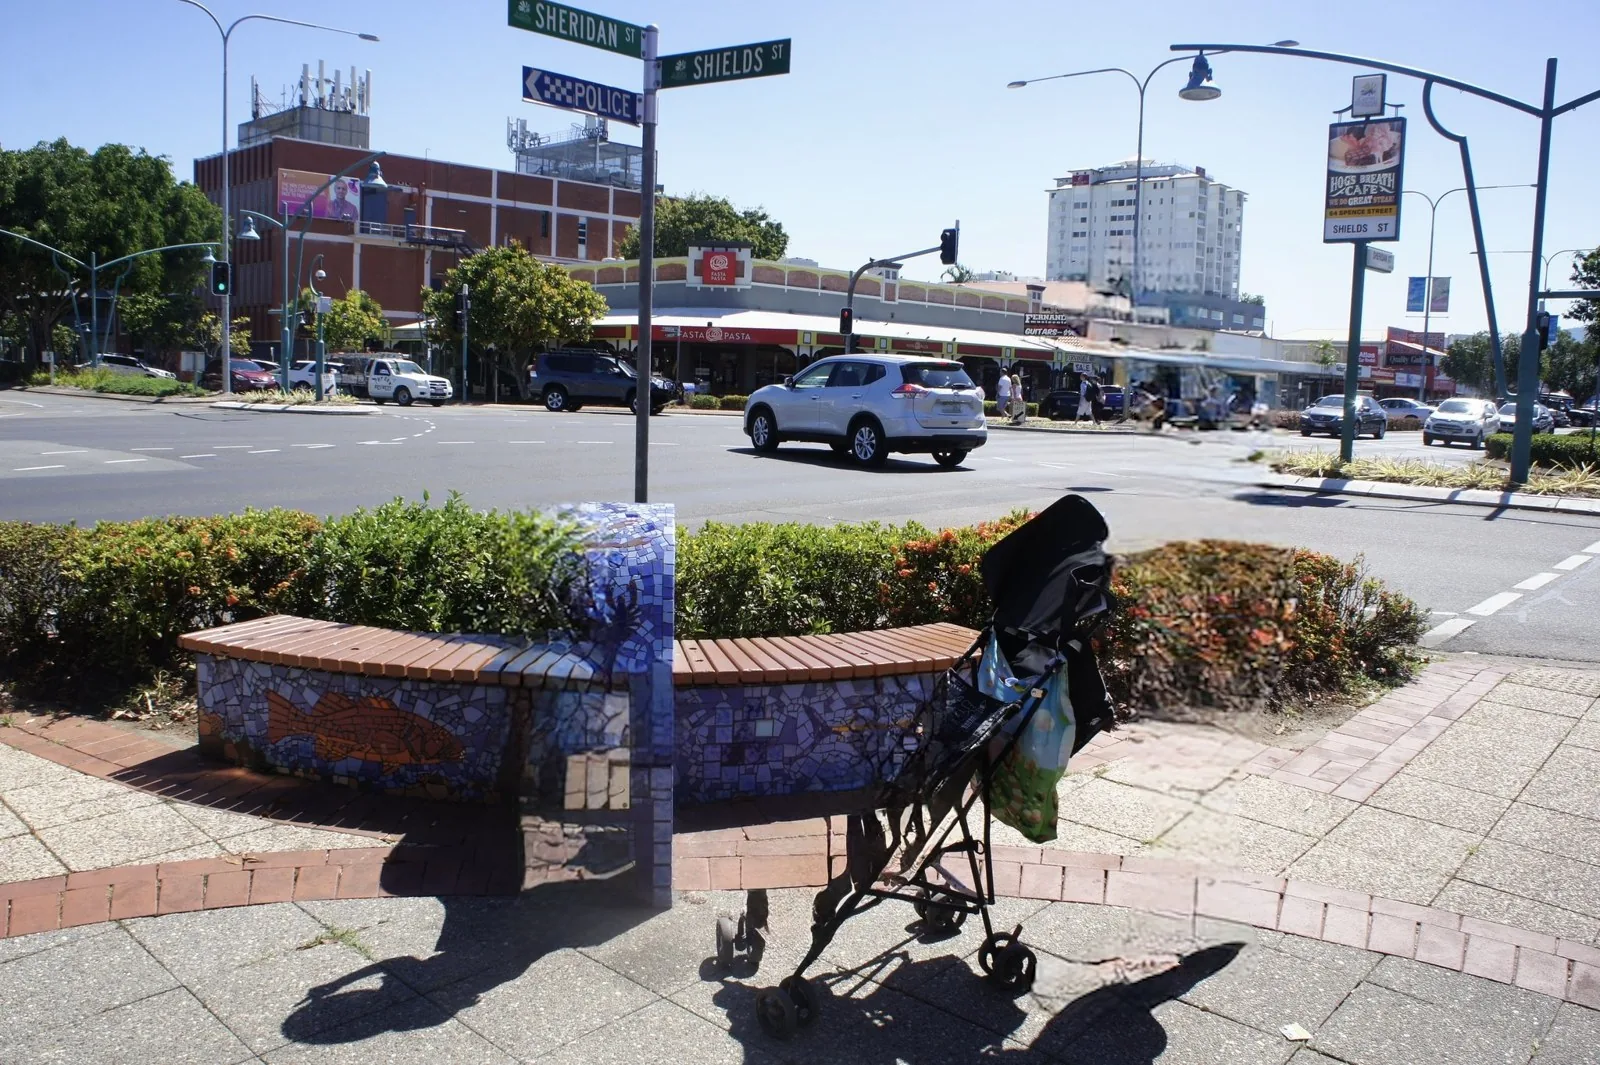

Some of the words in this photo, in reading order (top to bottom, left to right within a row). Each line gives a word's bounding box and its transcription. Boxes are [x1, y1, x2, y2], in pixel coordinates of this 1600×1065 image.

[535, 3, 618, 48] SHERIDAN
[625, 27, 636, 44] ST
[693, 47, 764, 80] SHIELDS
[771, 44, 784, 60] ST
[575, 82, 631, 118] POLICE
[1330, 175, 1356, 192] HOGS
[1359, 173, 1395, 190] BREATH
[1345, 184, 1378, 196] CAFE
[1348, 195, 1373, 206] GREAT
[1367, 207, 1393, 215] STREET
[1333, 224, 1368, 234] SHIELDS
[1377, 223, 1389, 233] ST
[724, 332, 751, 340] PASTA
